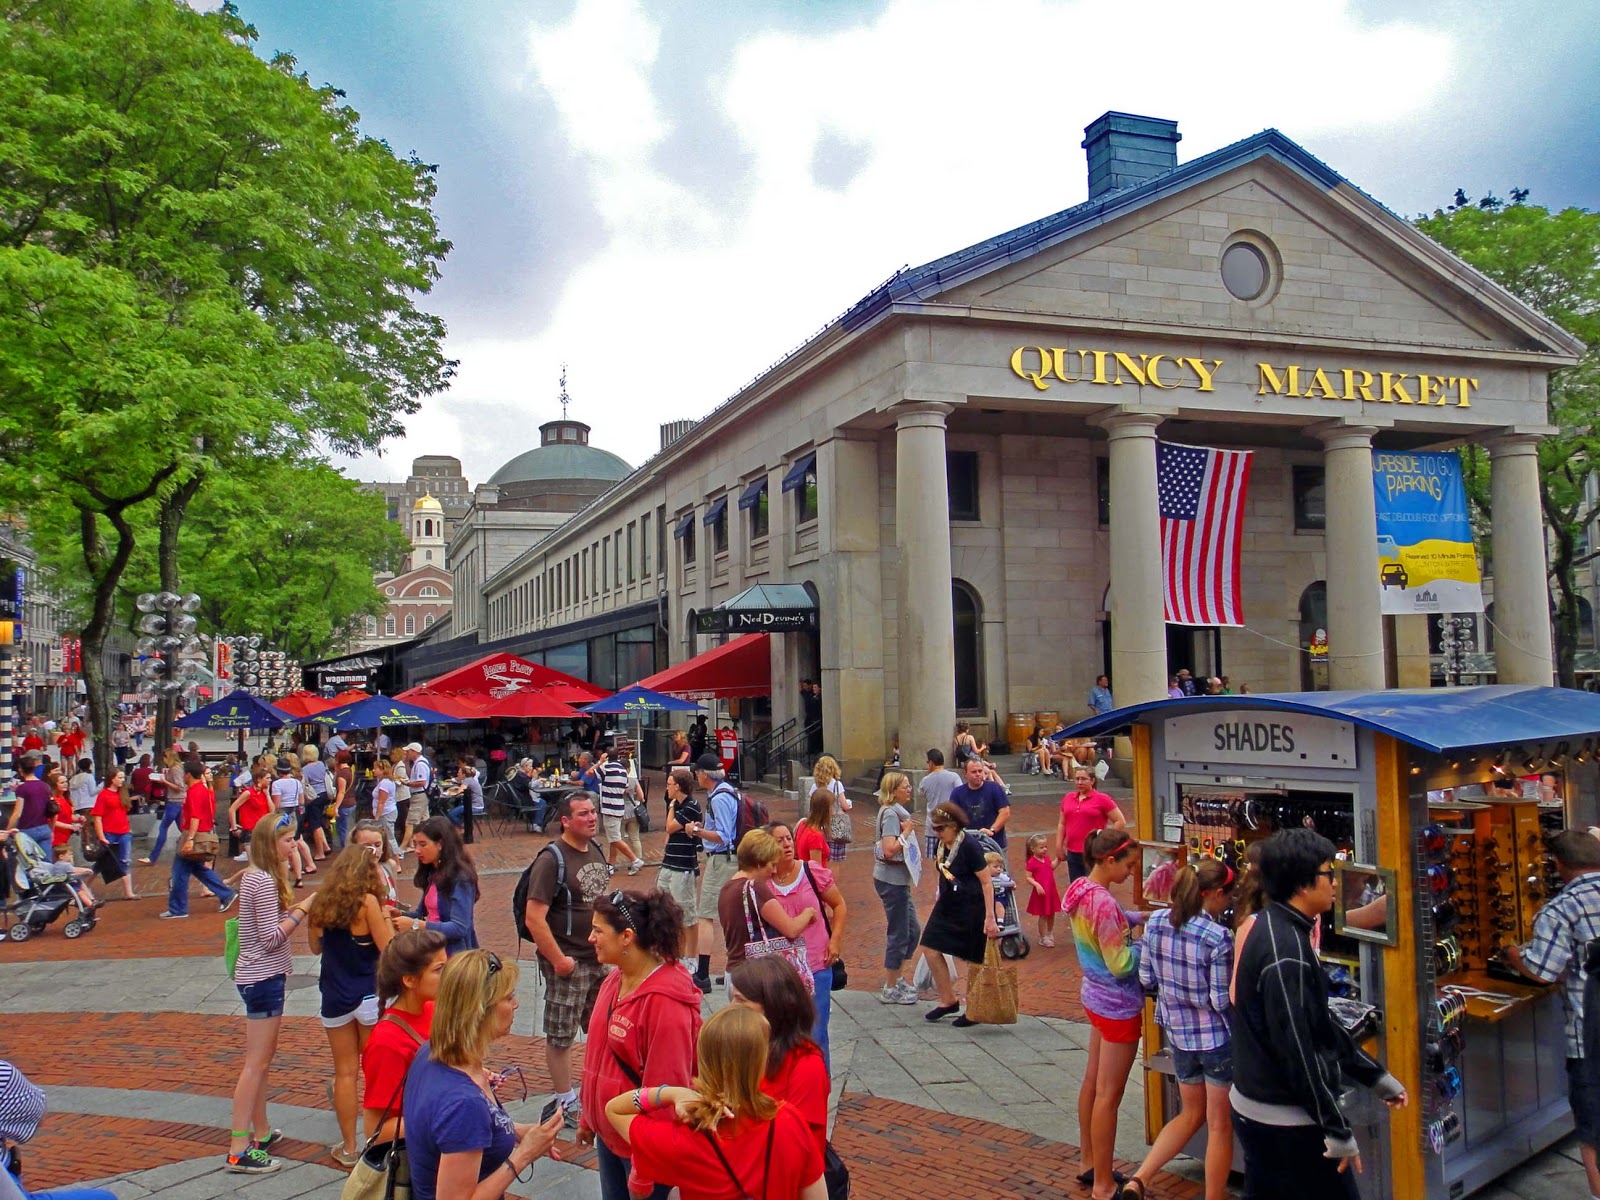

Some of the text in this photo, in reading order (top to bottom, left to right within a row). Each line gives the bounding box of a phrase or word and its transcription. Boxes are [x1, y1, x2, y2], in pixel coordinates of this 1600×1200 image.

[1010, 344, 1479, 408] QUINCY MARKET
[1372, 454, 1421, 473] URBSIDE
[1421, 456, 1435, 475] TO
[1386, 475, 1442, 502] PARKING
[740, 613, 762, 626] Ned
[510, 660, 534, 676] PLOW
[325, 675, 367, 683] wagamama
[1213, 722, 1295, 753] SHADES
